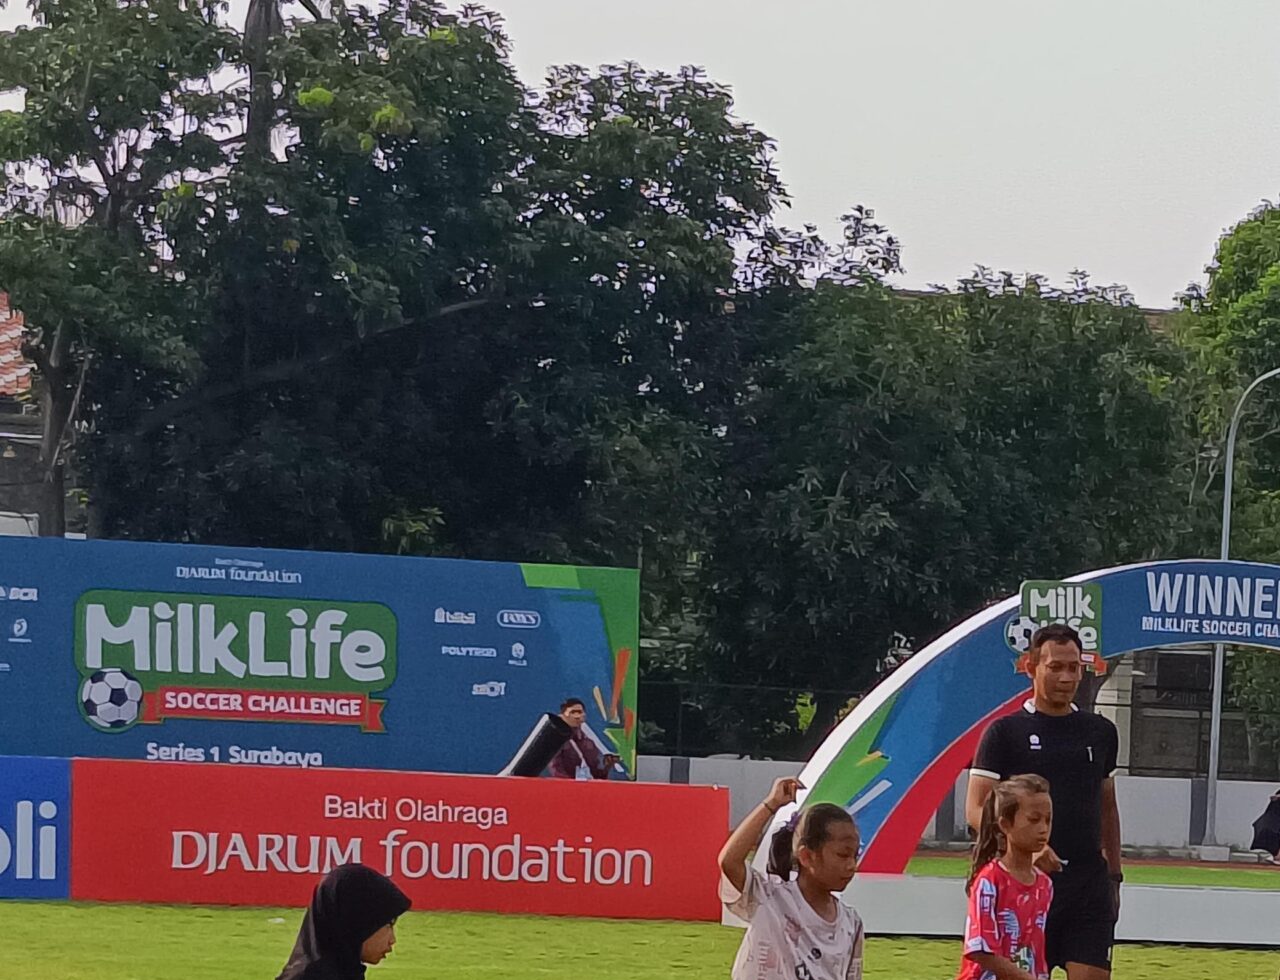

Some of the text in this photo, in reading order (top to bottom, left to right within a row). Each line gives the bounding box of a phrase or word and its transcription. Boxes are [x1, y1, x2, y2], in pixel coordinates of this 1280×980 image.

[1030, 587, 1095, 619] Milk
[86, 602, 386, 681] MilkLife
[1142, 616, 1199, 634] MILKLIFE
[1202, 620, 1251, 637] SOCCER
[165, 691, 361, 716] SOCCER CHALLENGE
[146, 742, 323, 768] Series 1 Surabaya
[324, 795, 508, 830] Bakti Olahraga
[0, 800, 57, 880] li
[171, 829, 653, 886] DJARUM foundation
